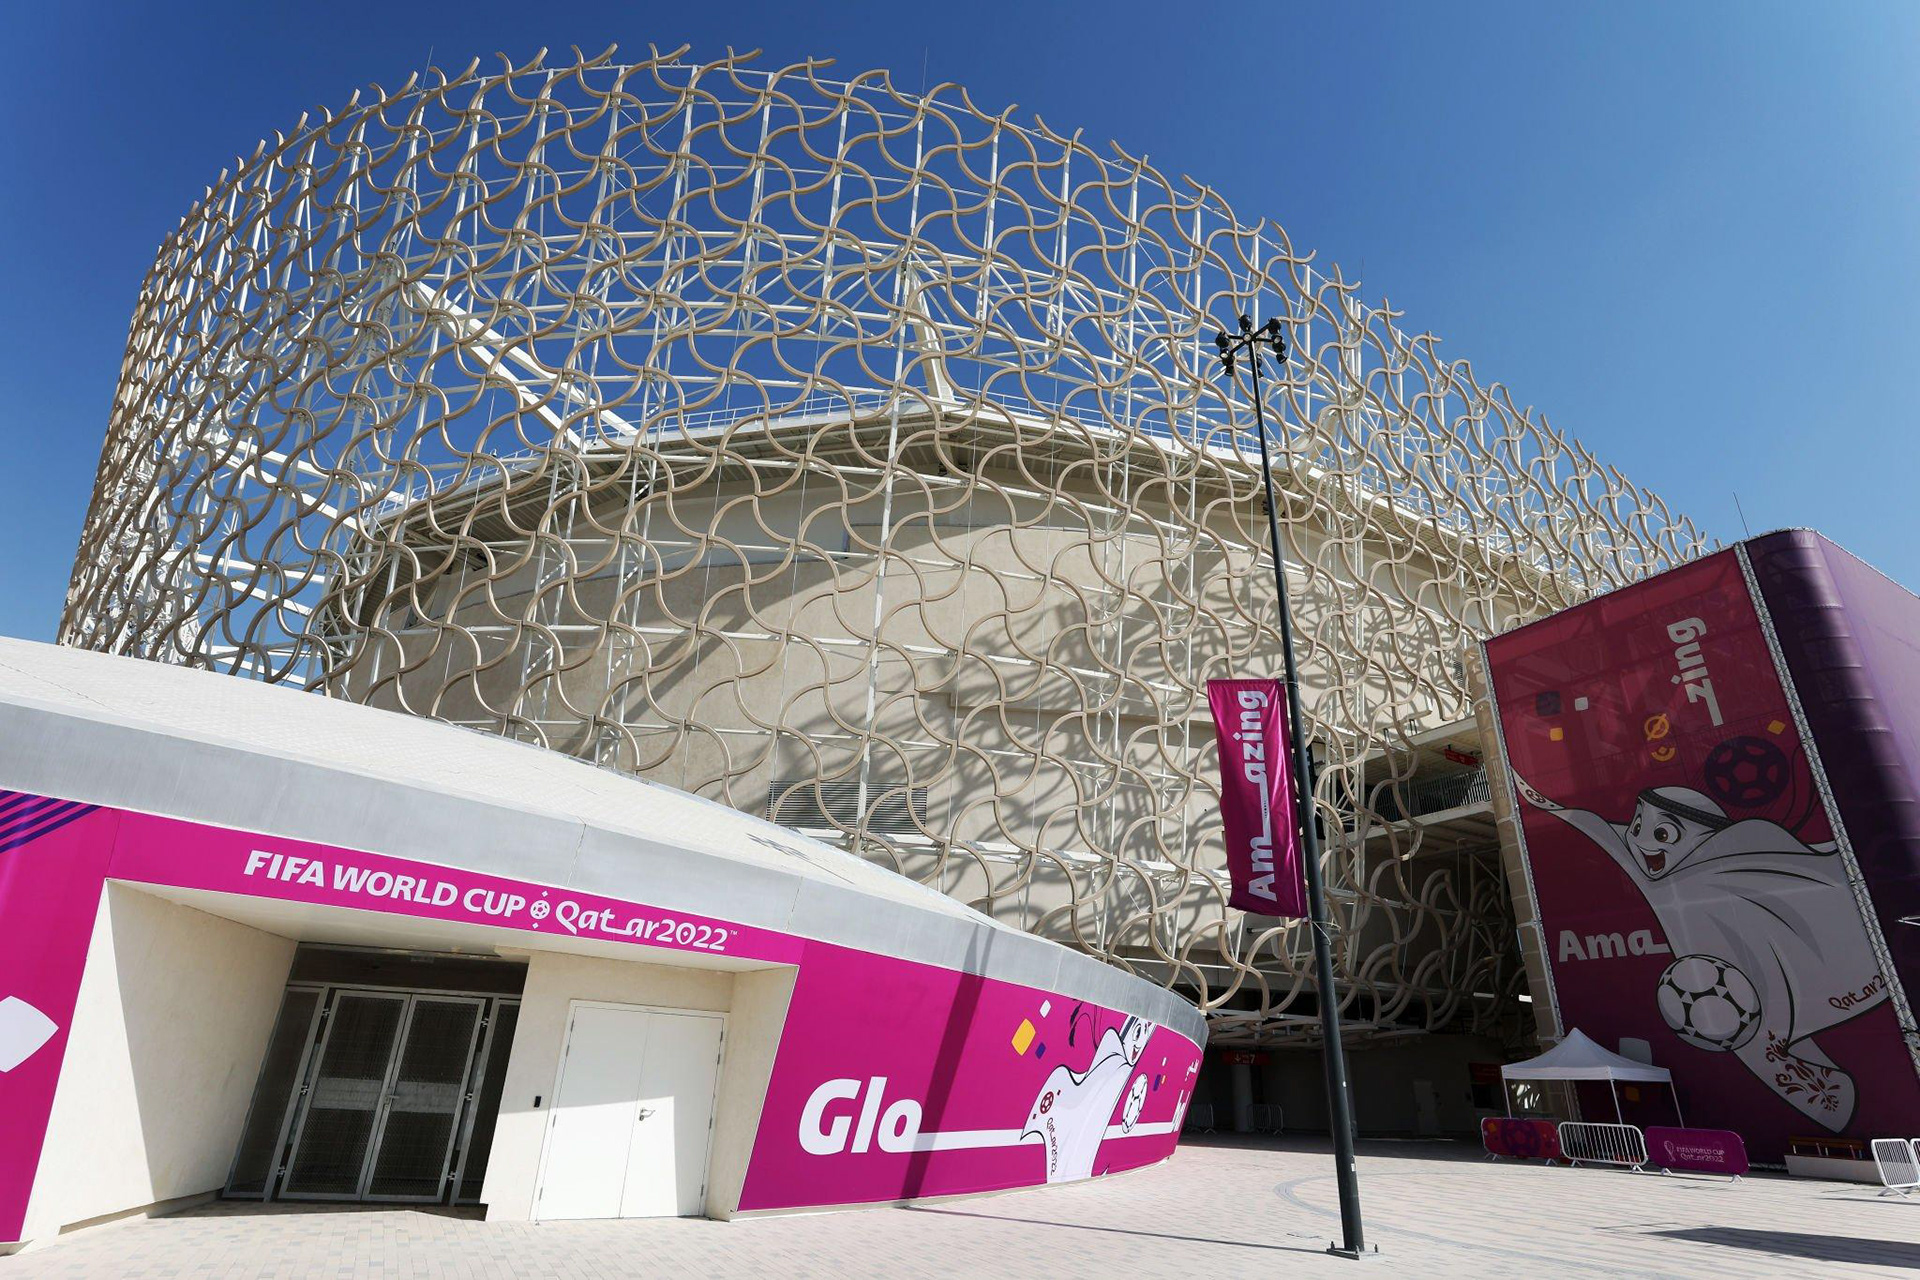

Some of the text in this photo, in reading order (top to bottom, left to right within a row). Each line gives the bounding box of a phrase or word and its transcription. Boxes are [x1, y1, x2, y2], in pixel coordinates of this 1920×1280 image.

[243, 849, 325, 887] FIFA
[332, 864, 459, 909] WORLD
[462, 887, 526, 919] CUP
[799, 1076, 923, 1156] Glo
